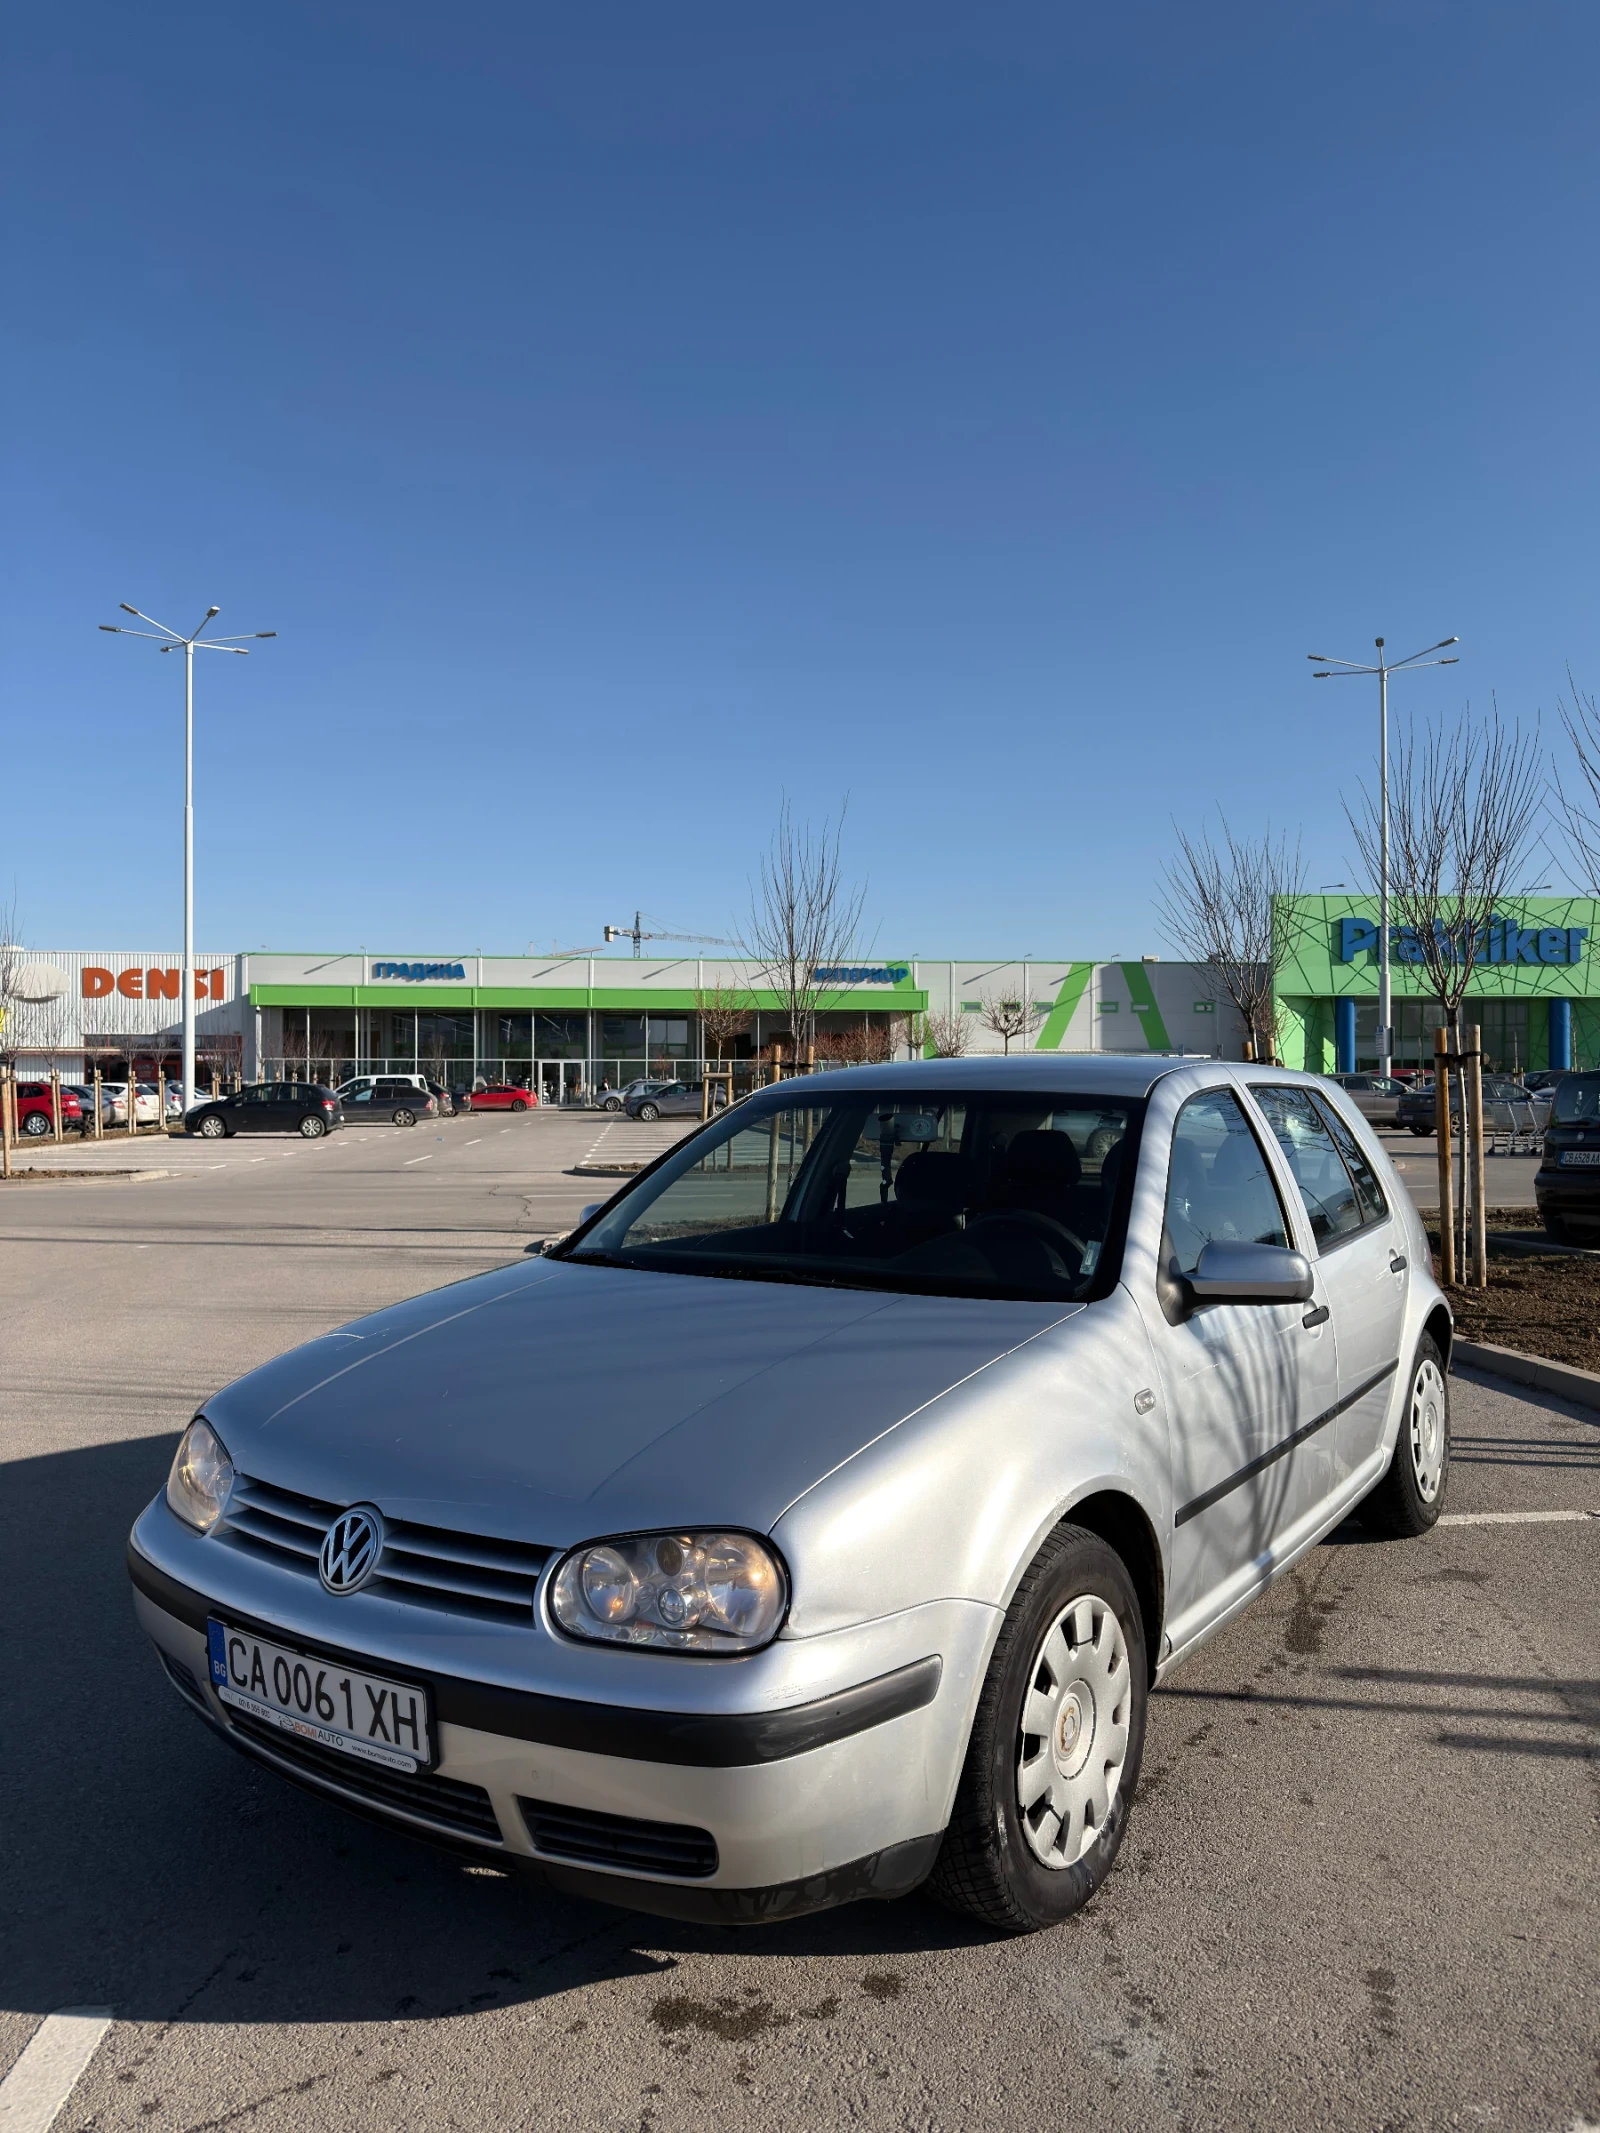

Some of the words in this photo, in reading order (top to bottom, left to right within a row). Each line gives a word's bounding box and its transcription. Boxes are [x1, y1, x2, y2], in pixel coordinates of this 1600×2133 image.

[1341, 913, 1588, 963] Praktiker
[375, 962, 466, 981] ГРАДИНА
[814, 967, 909, 983] ИНТЕРИОР
[214, 1660, 226, 1678] BG
[293, 1721, 317, 1740] BOMI
[318, 1729, 344, 1747] AUTO
